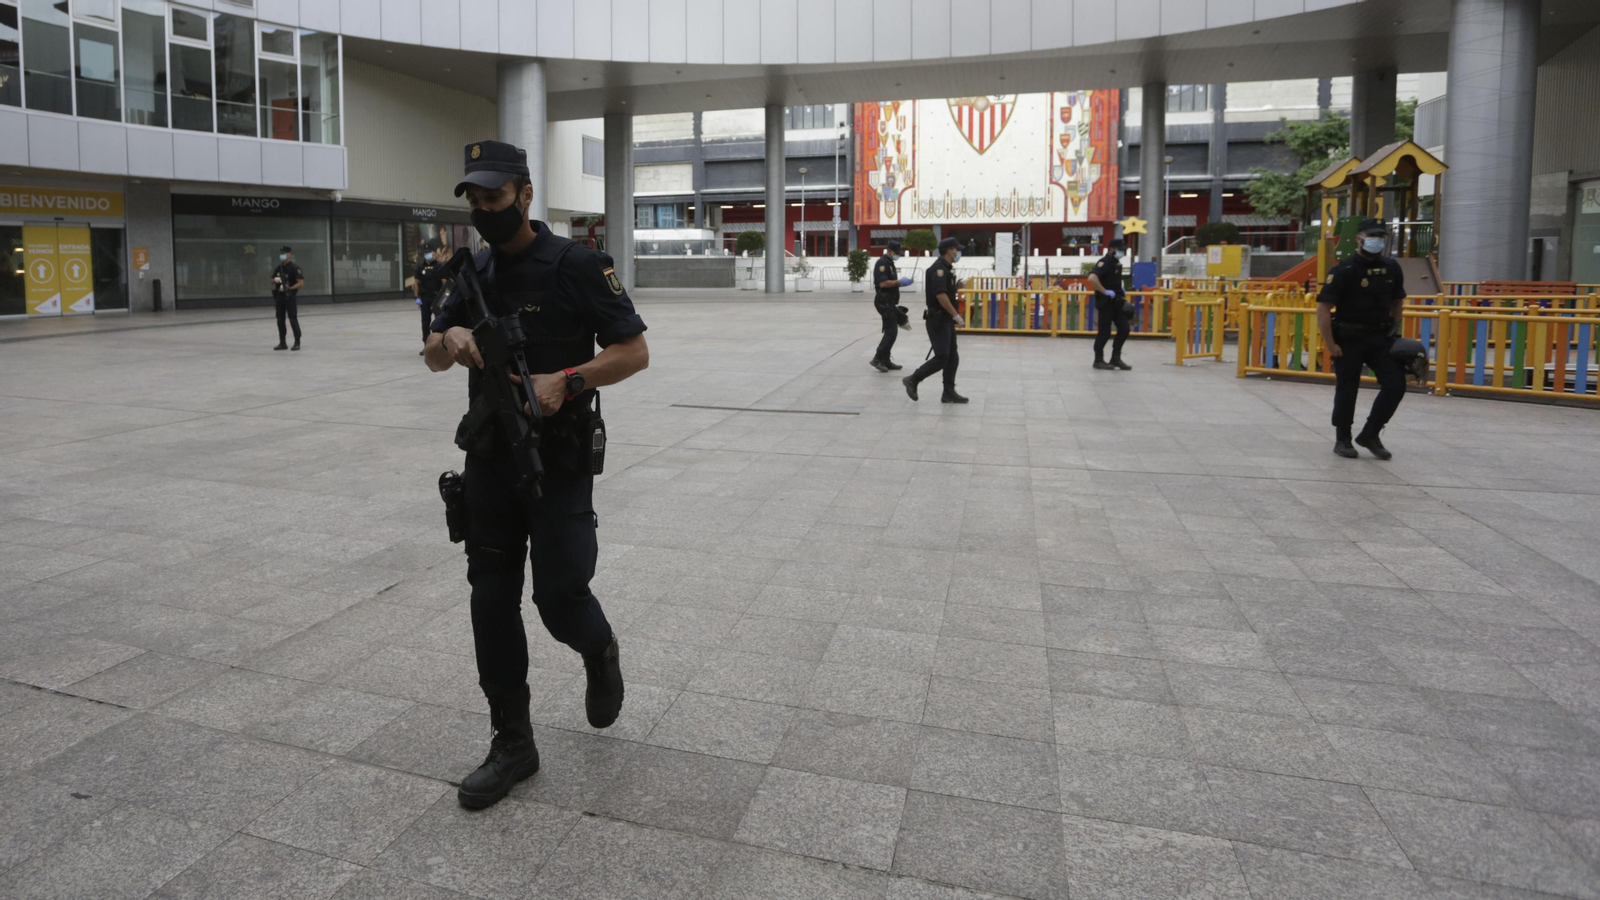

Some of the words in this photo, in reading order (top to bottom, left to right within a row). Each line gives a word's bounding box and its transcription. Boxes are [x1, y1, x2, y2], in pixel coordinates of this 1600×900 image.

[0, 193, 111, 211] BIENVENIDO
[231, 198, 280, 208] MANGO
[412, 208, 437, 217] MANGO
